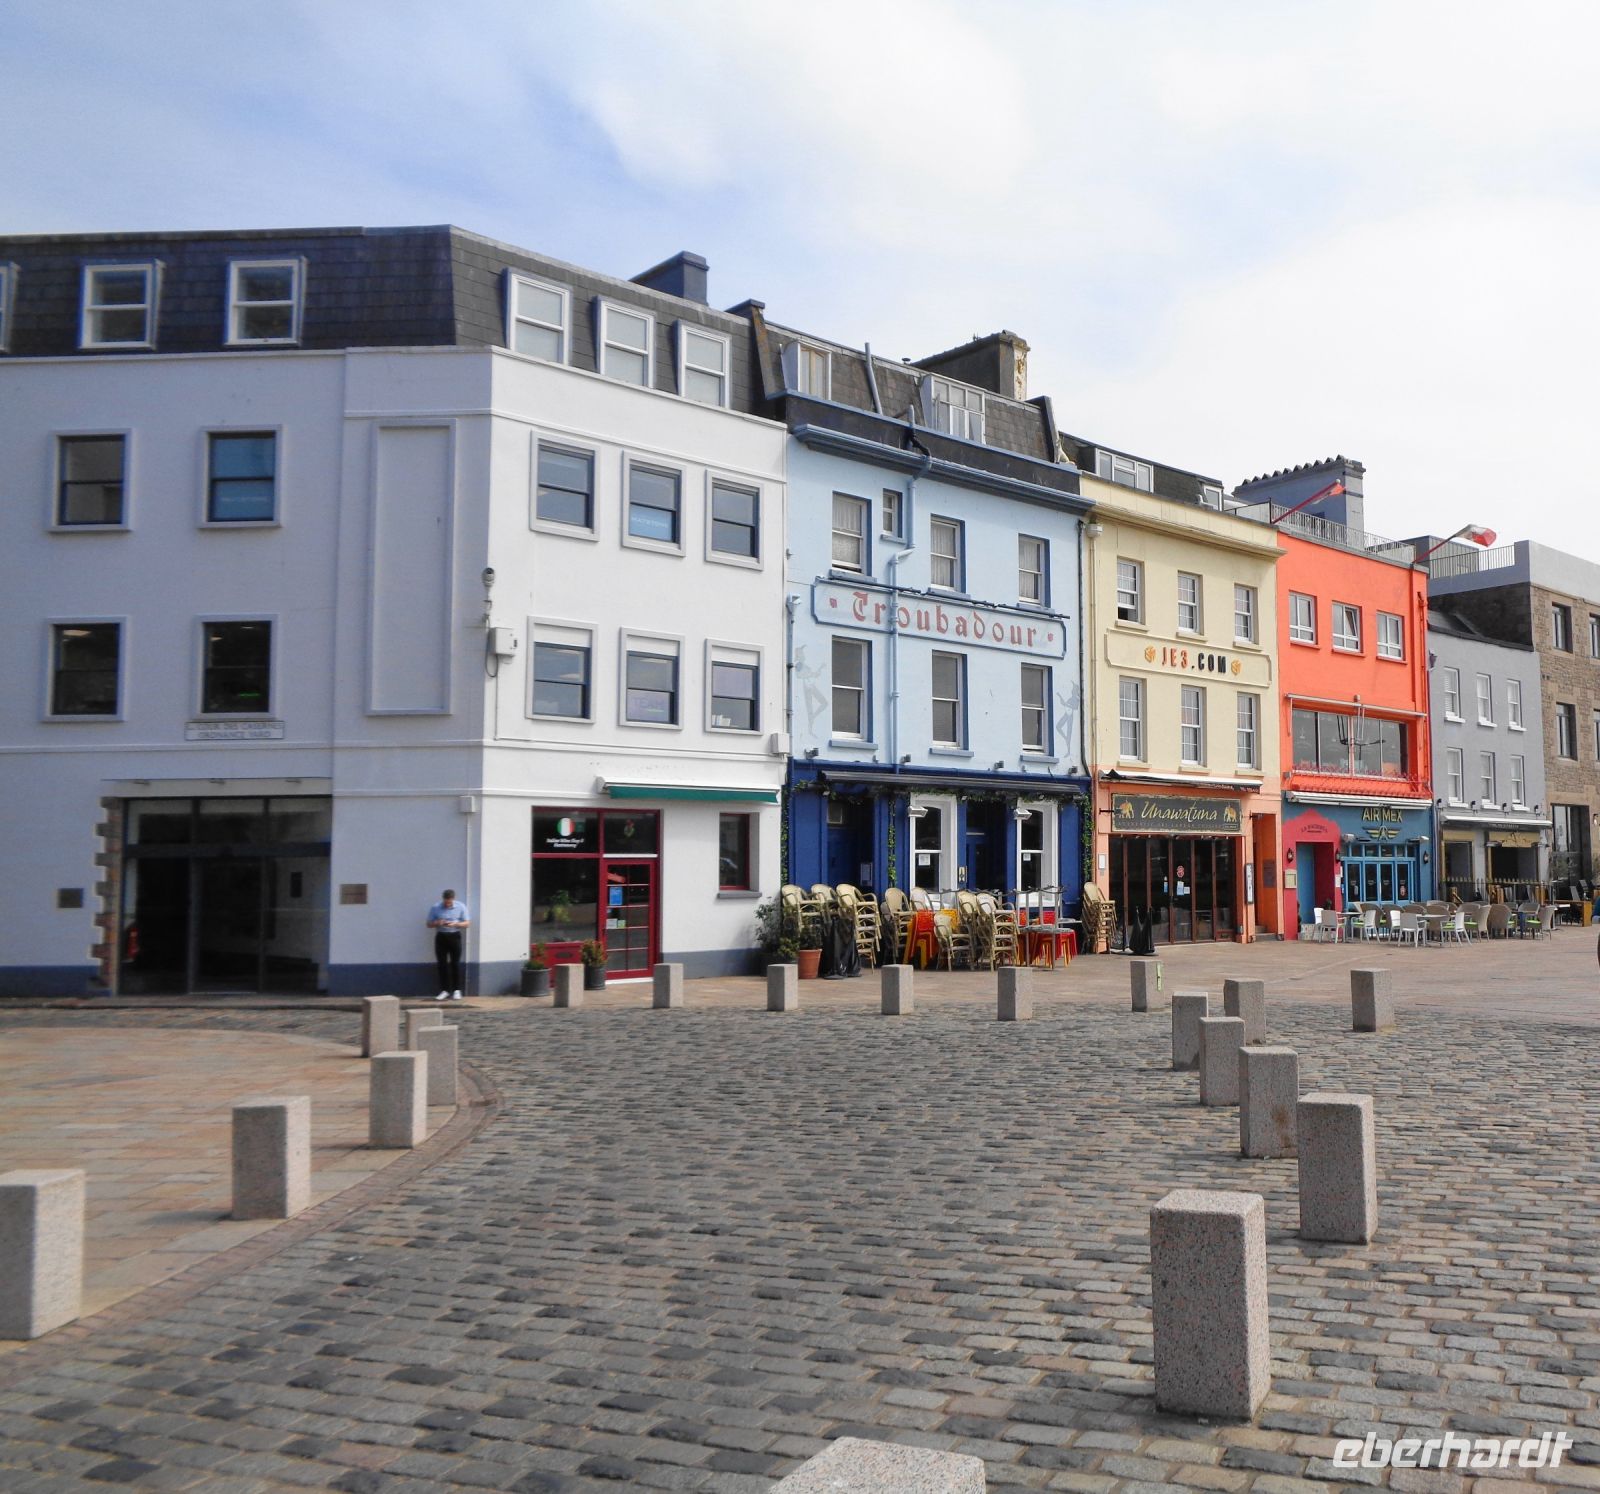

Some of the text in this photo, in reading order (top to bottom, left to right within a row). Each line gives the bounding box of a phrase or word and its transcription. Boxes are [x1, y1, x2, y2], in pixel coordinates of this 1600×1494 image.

[853, 591, 1037, 647] Troubadour
[1161, 646, 1227, 674] JE3.COM
[1141, 801, 1217, 822] Unawatuna
[1362, 807, 1403, 823] AIR MEX
